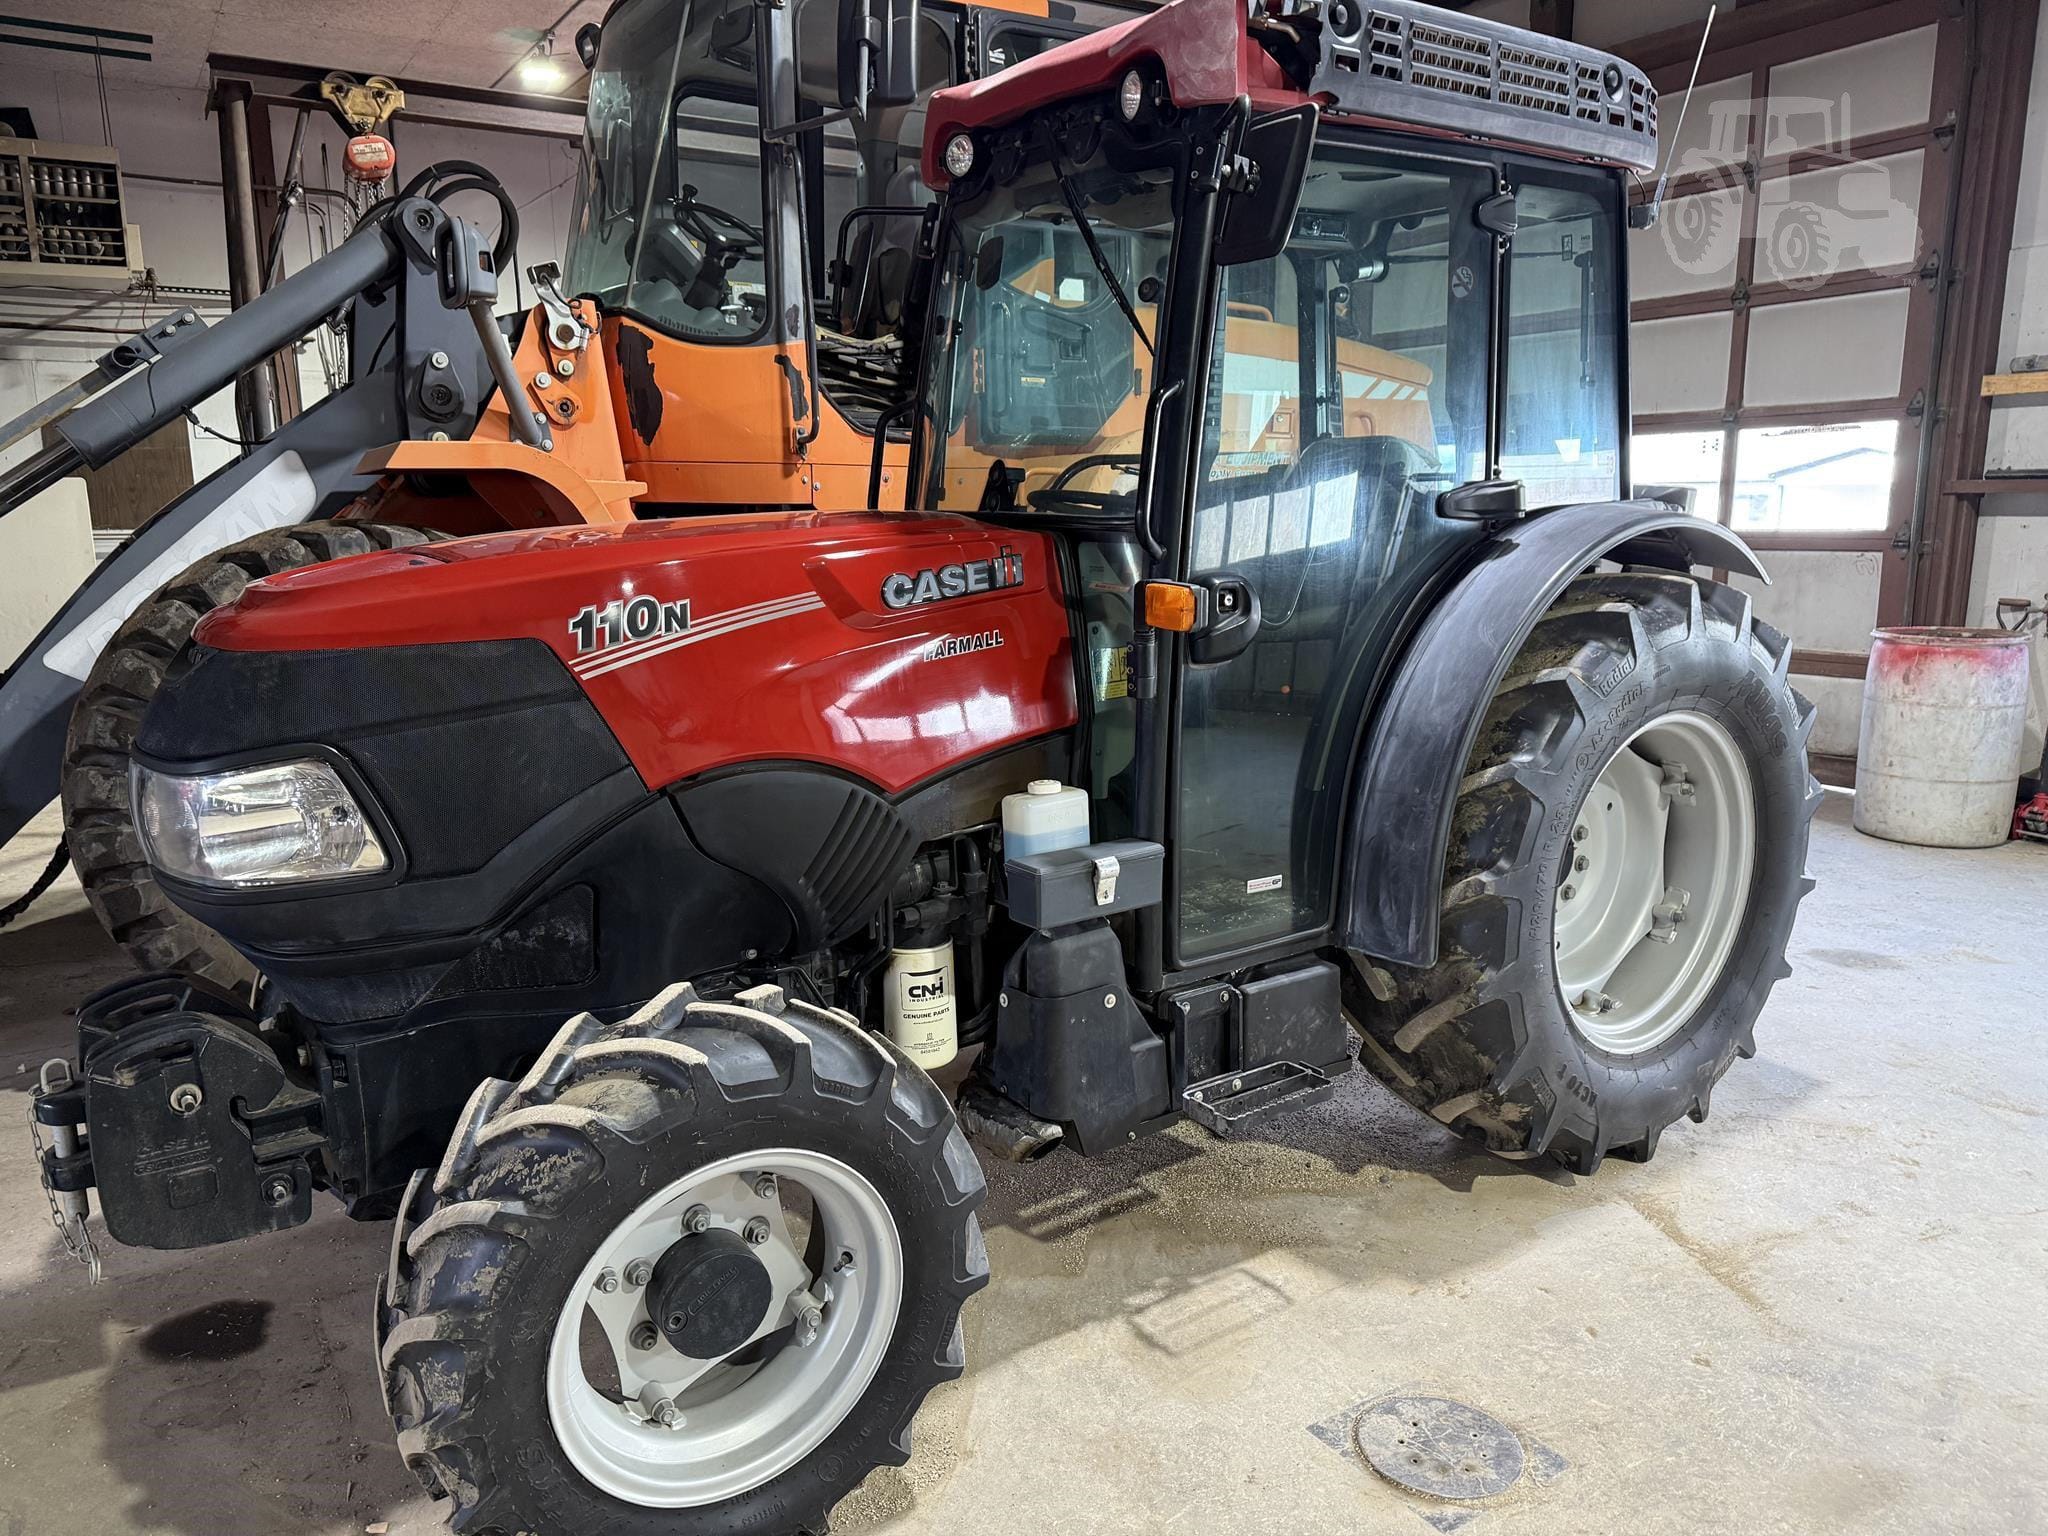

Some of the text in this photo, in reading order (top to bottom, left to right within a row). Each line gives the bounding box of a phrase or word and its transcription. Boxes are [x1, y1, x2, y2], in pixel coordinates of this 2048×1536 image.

[881, 559, 990, 609] CASE
[568, 594, 691, 655] 110N
[924, 629, 1004, 662] FARMALL
[1600, 656, 1634, 698] Radial
[909, 994, 944, 1002] INDUSTRIAL
[933, 1007, 950, 1017] PARTS
